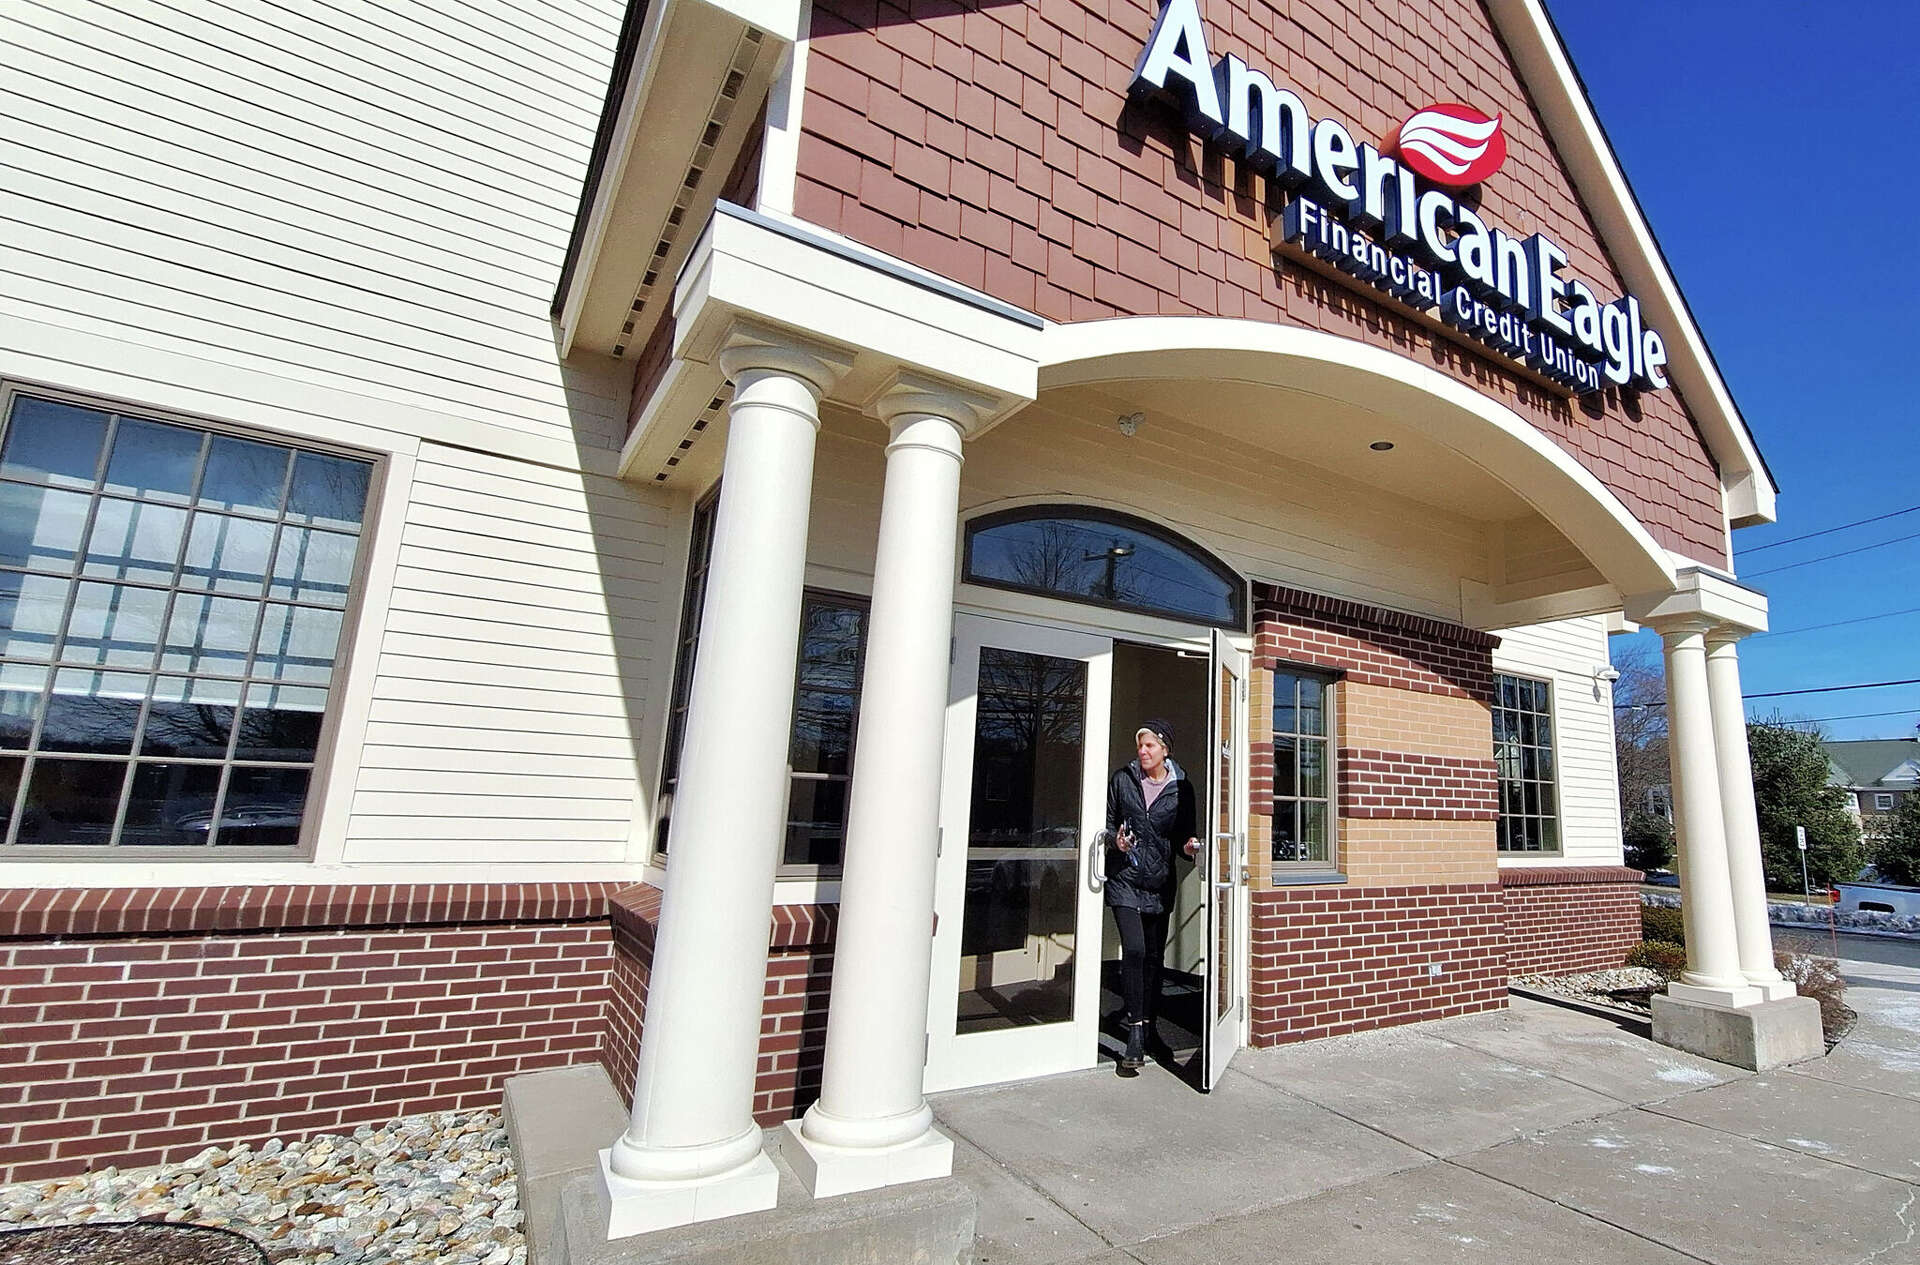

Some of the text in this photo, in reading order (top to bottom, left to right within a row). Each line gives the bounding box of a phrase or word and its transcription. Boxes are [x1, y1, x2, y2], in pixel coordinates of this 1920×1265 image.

[1300, 196, 1599, 390] Financial Credit Union
